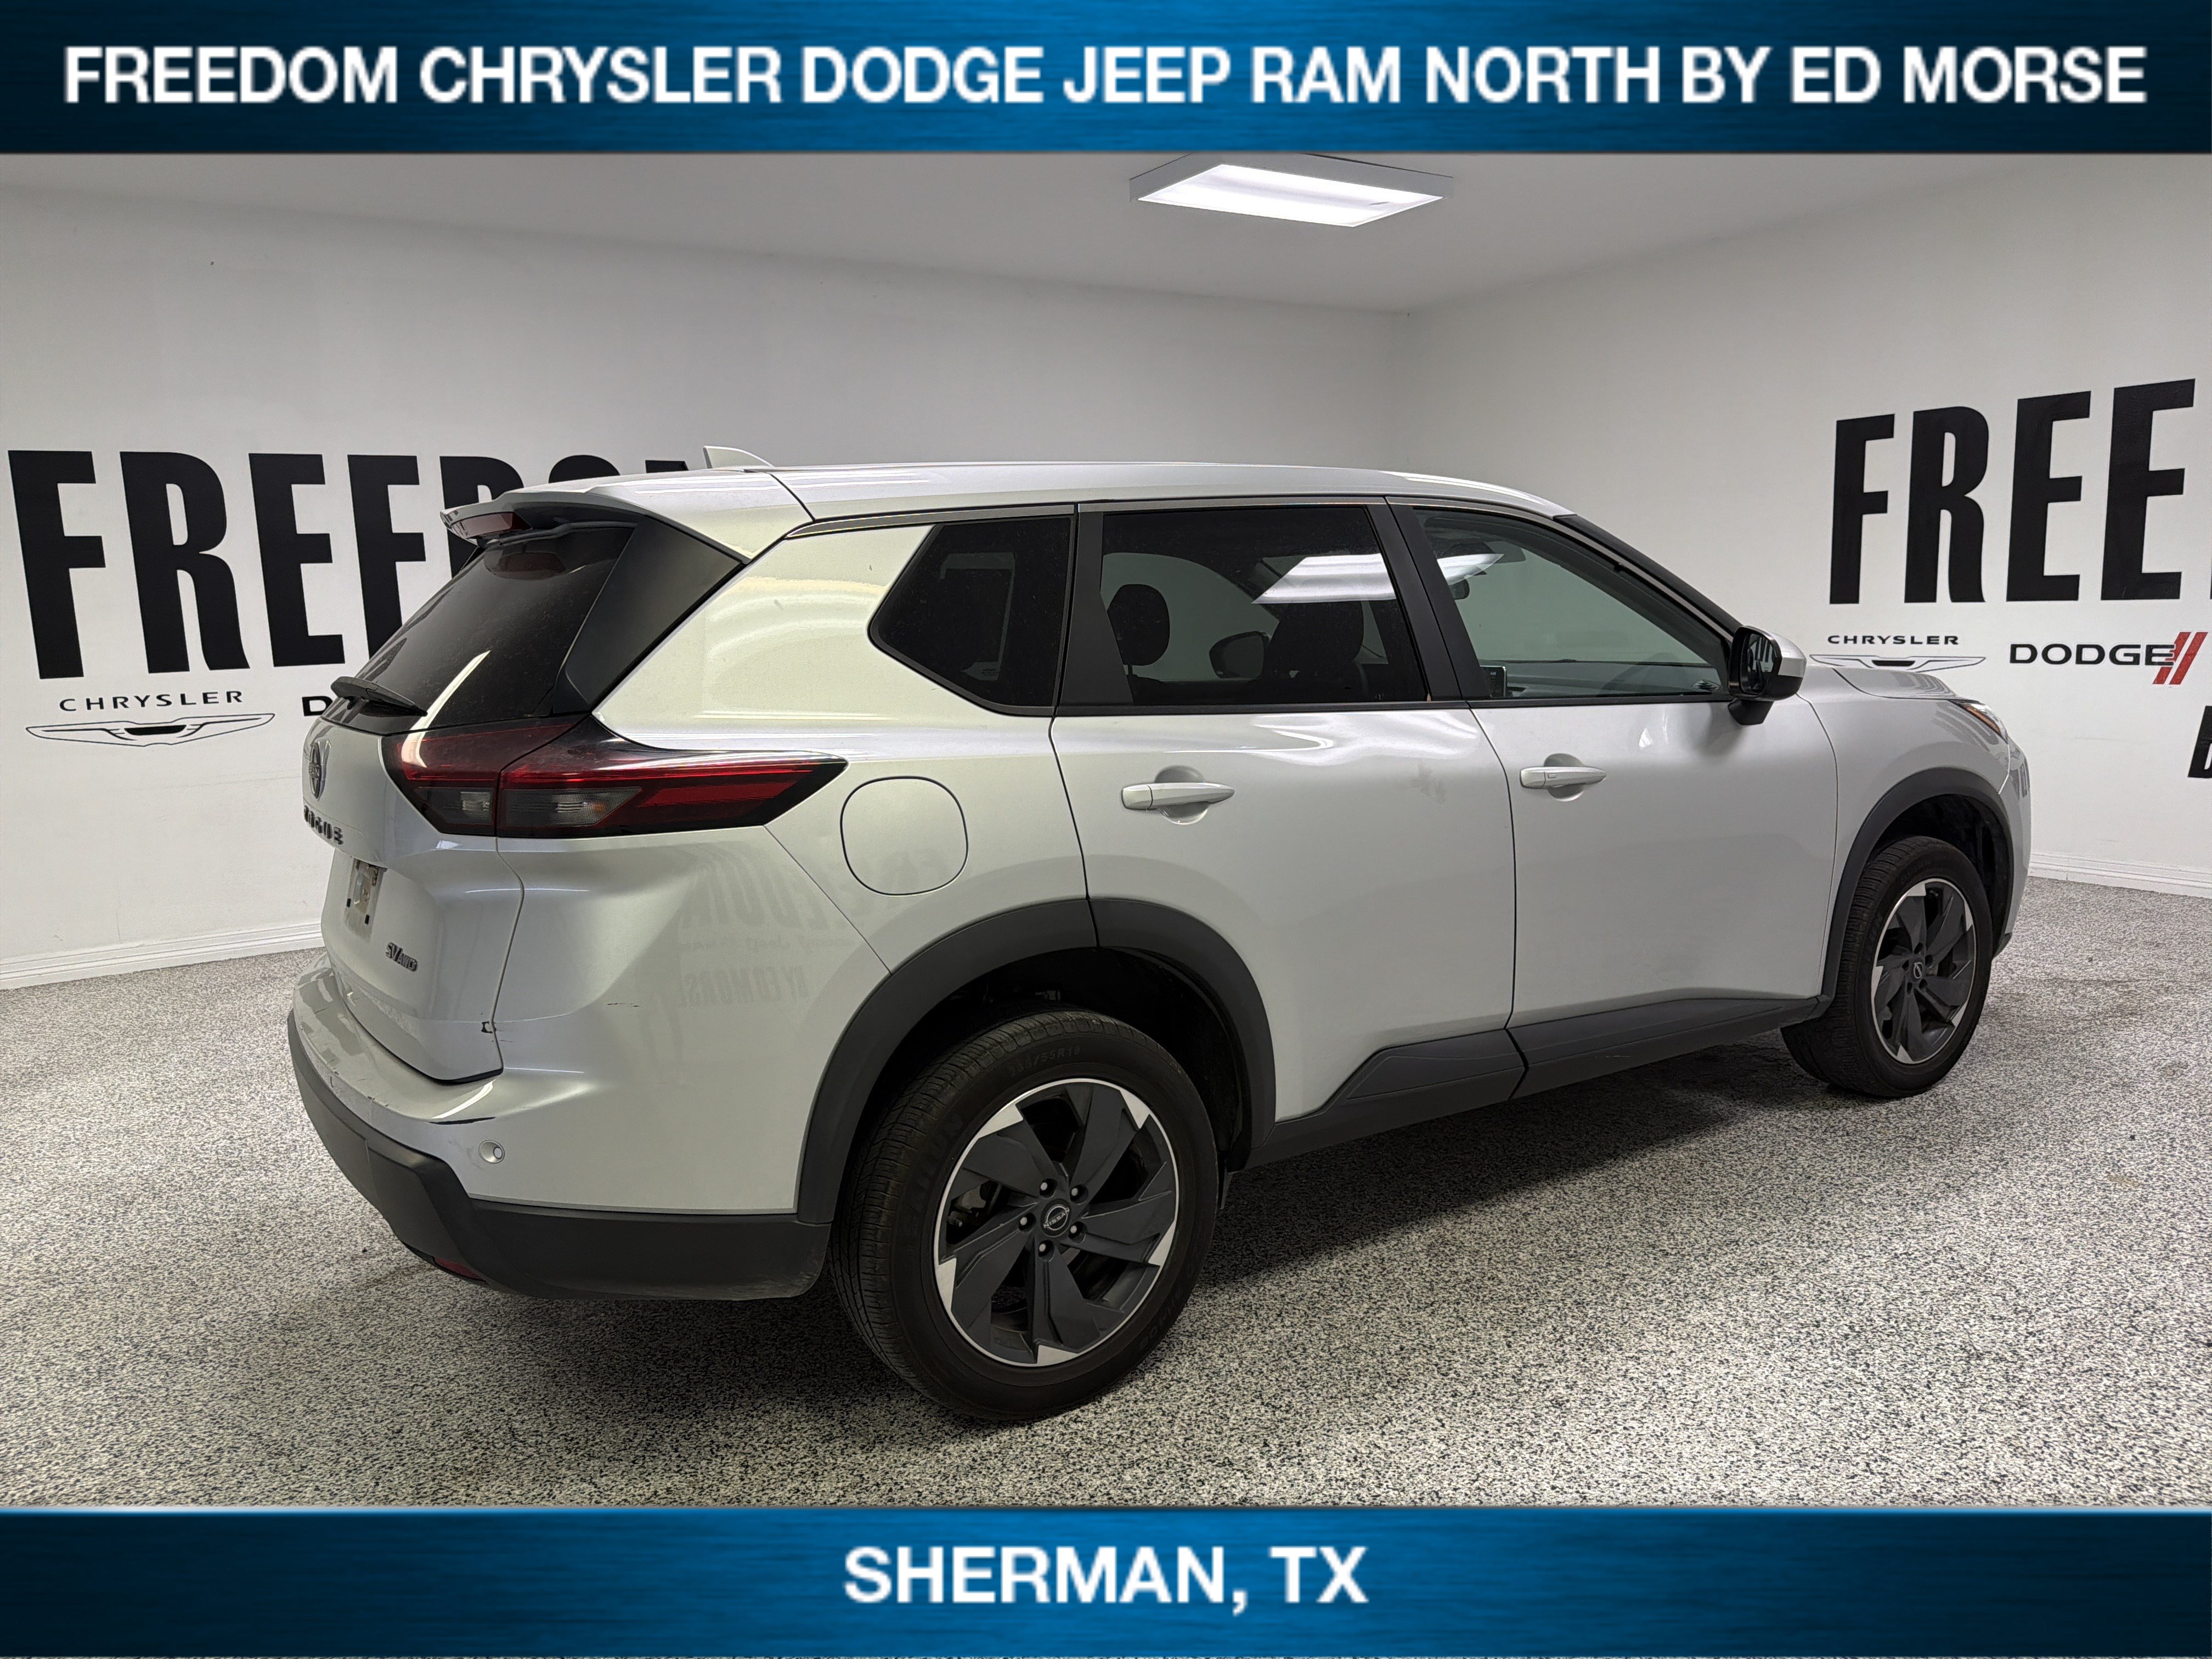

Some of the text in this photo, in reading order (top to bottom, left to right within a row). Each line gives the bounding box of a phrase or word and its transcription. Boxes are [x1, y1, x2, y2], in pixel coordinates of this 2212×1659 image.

[1829, 379, 2212, 605] FREE
[1827, 635, 1959, 646] CHRYSLER
[2010, 643, 2175, 666] DODGE
[59, 691, 244, 712] CHRYSLER
[1043, 1207, 1070, 1229] NISSAN
